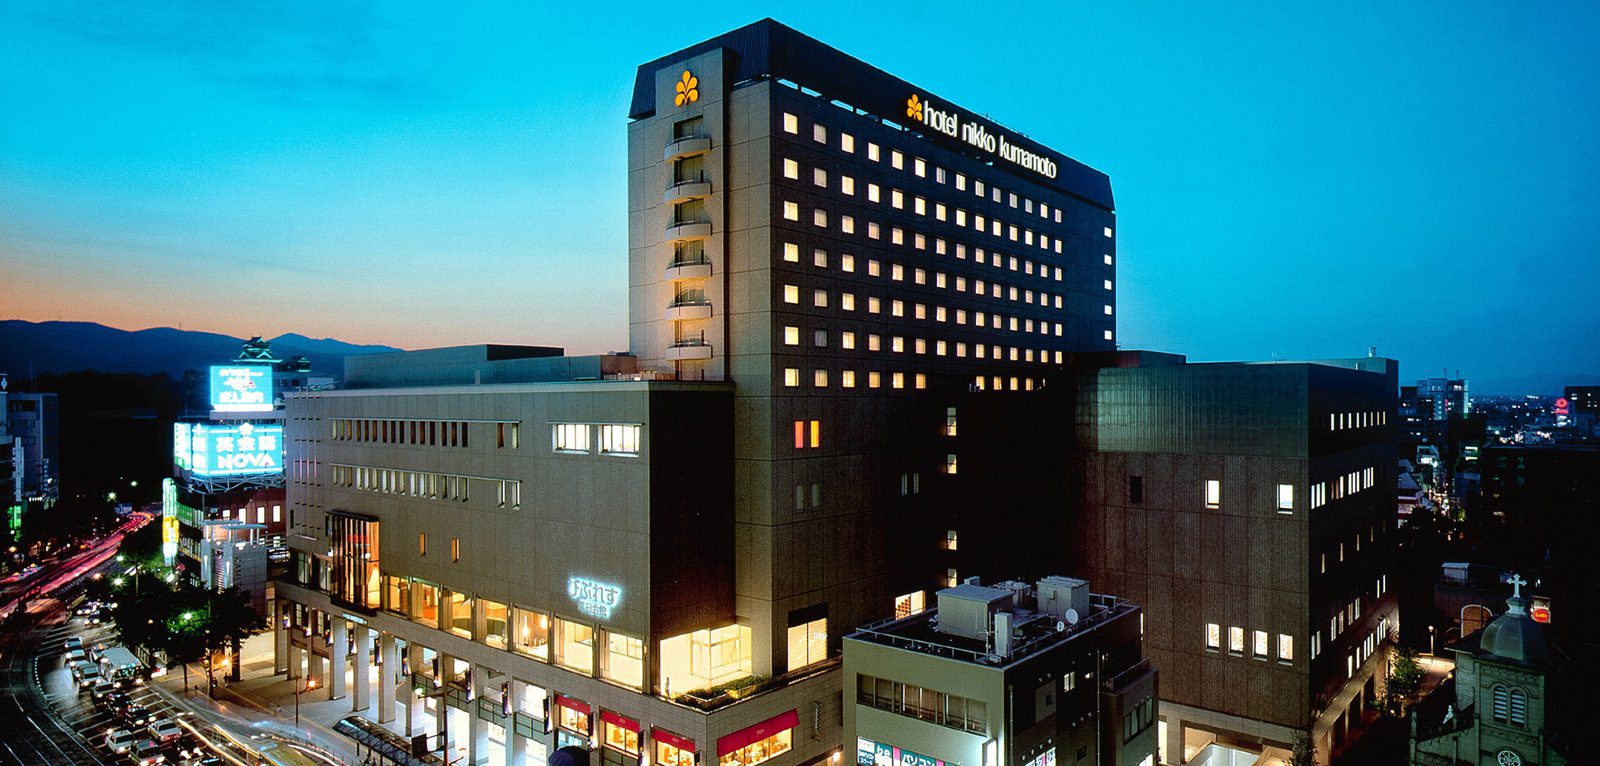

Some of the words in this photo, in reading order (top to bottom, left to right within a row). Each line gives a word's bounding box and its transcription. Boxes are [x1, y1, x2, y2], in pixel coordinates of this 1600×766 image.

[924, 101, 957, 137] hotel
[962, 123, 995, 153] nikko
[999, 135, 1057, 178] kumamoto
[218, 453, 276, 470] NOVA
